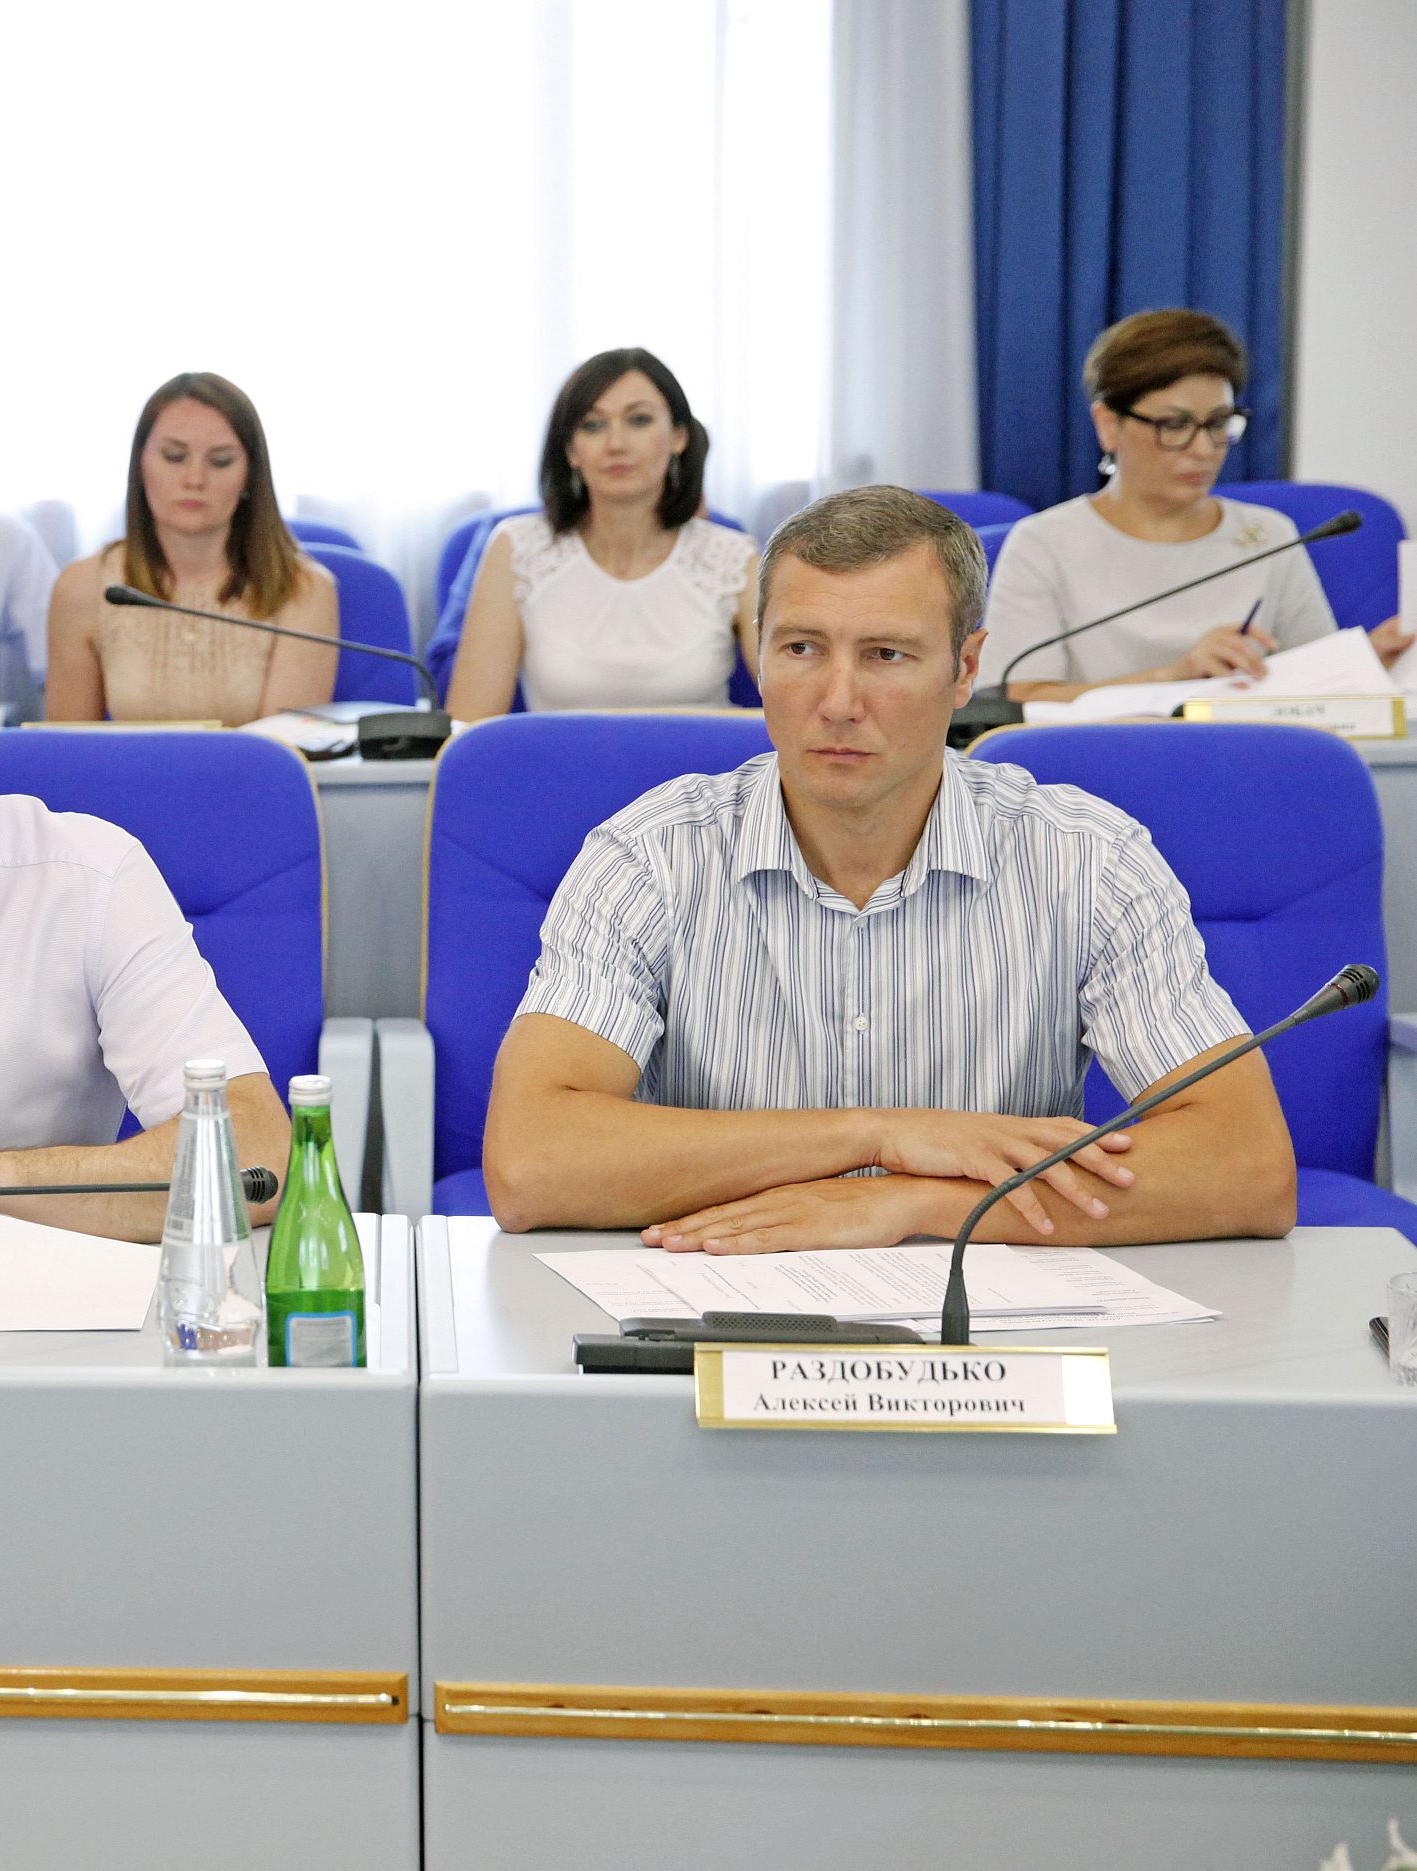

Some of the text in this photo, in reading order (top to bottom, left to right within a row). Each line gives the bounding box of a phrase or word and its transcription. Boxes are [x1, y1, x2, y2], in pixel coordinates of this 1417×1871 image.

[771, 1359, 1007, 1384] РАЗДОБУДЬКО
[753, 1392, 1025, 1417] Алексей Викторович
